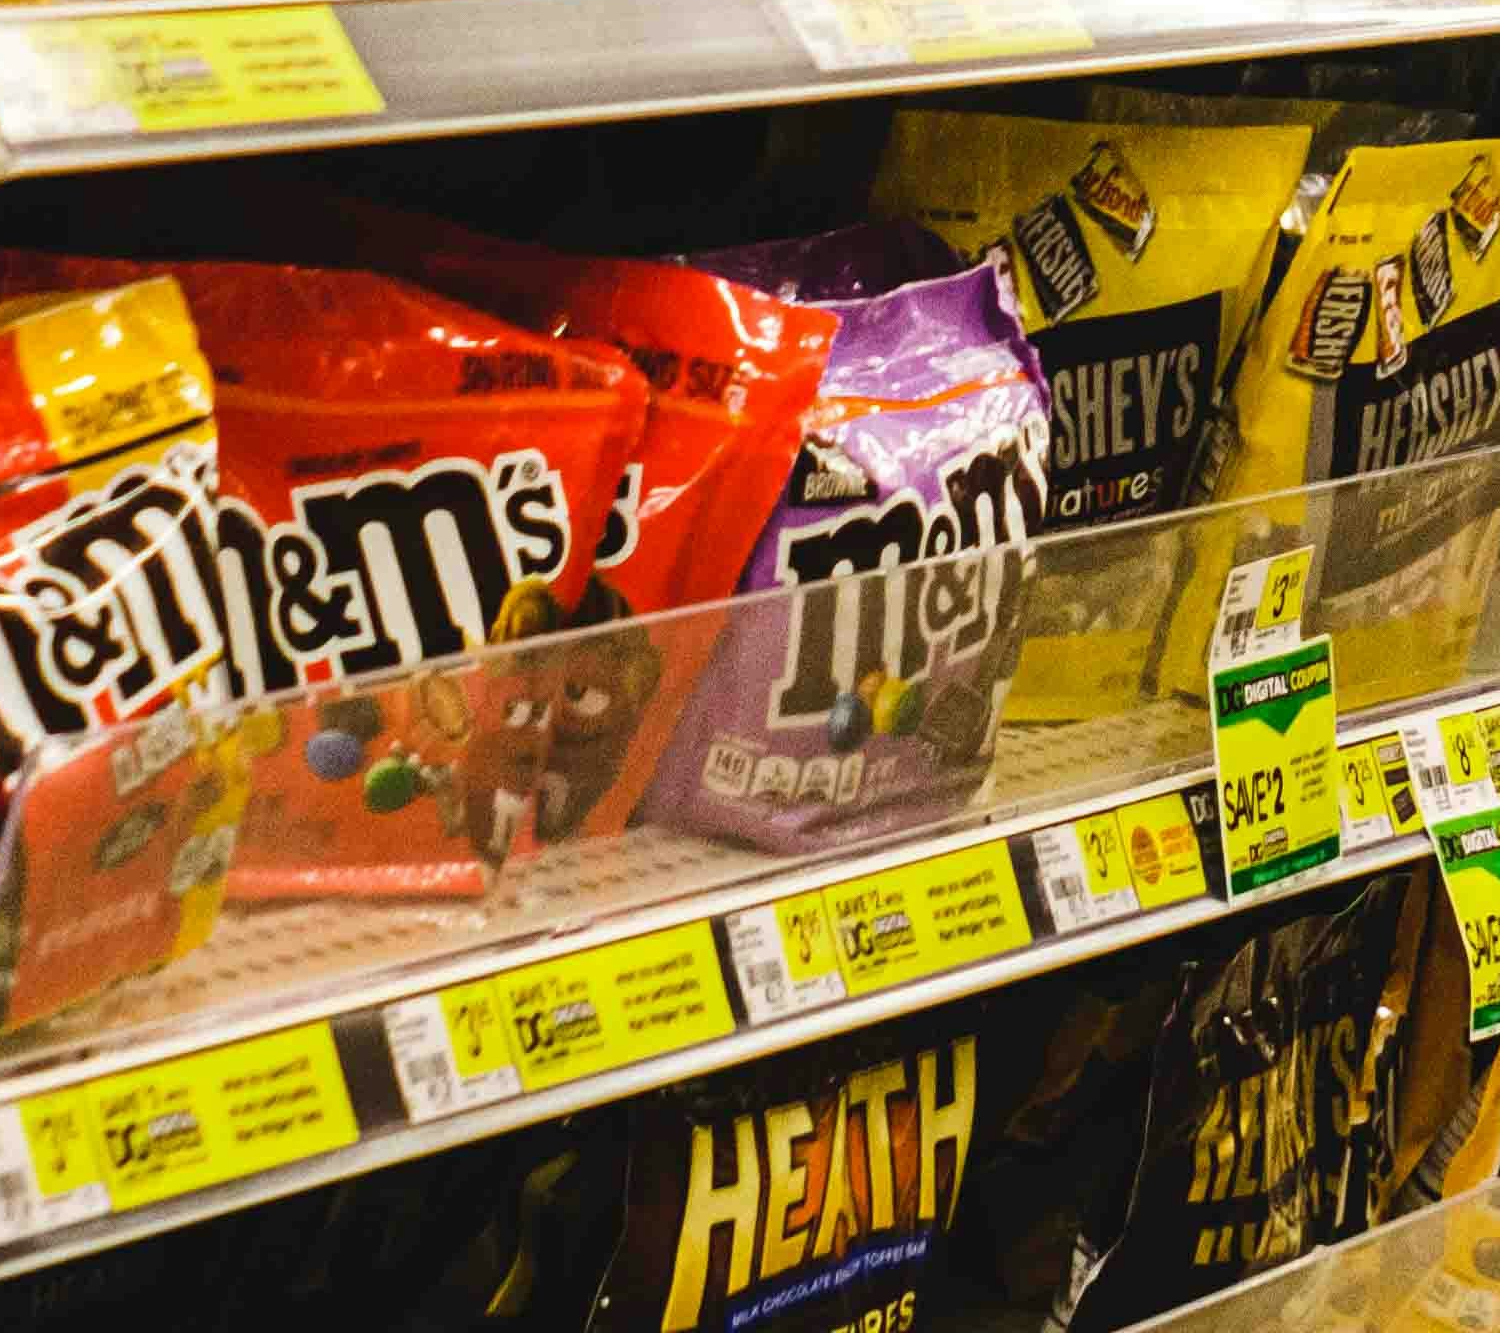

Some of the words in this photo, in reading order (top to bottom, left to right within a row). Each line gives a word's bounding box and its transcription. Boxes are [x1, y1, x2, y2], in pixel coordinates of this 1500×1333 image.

[1052, 342, 1201, 472] SHEY'S
[1243, 673, 1288, 706] DIGITAL
[1223, 769, 1269, 832] SAVE
[1464, 913, 1499, 971] SAVE
[660, 1035, 978, 1333] HEATH
